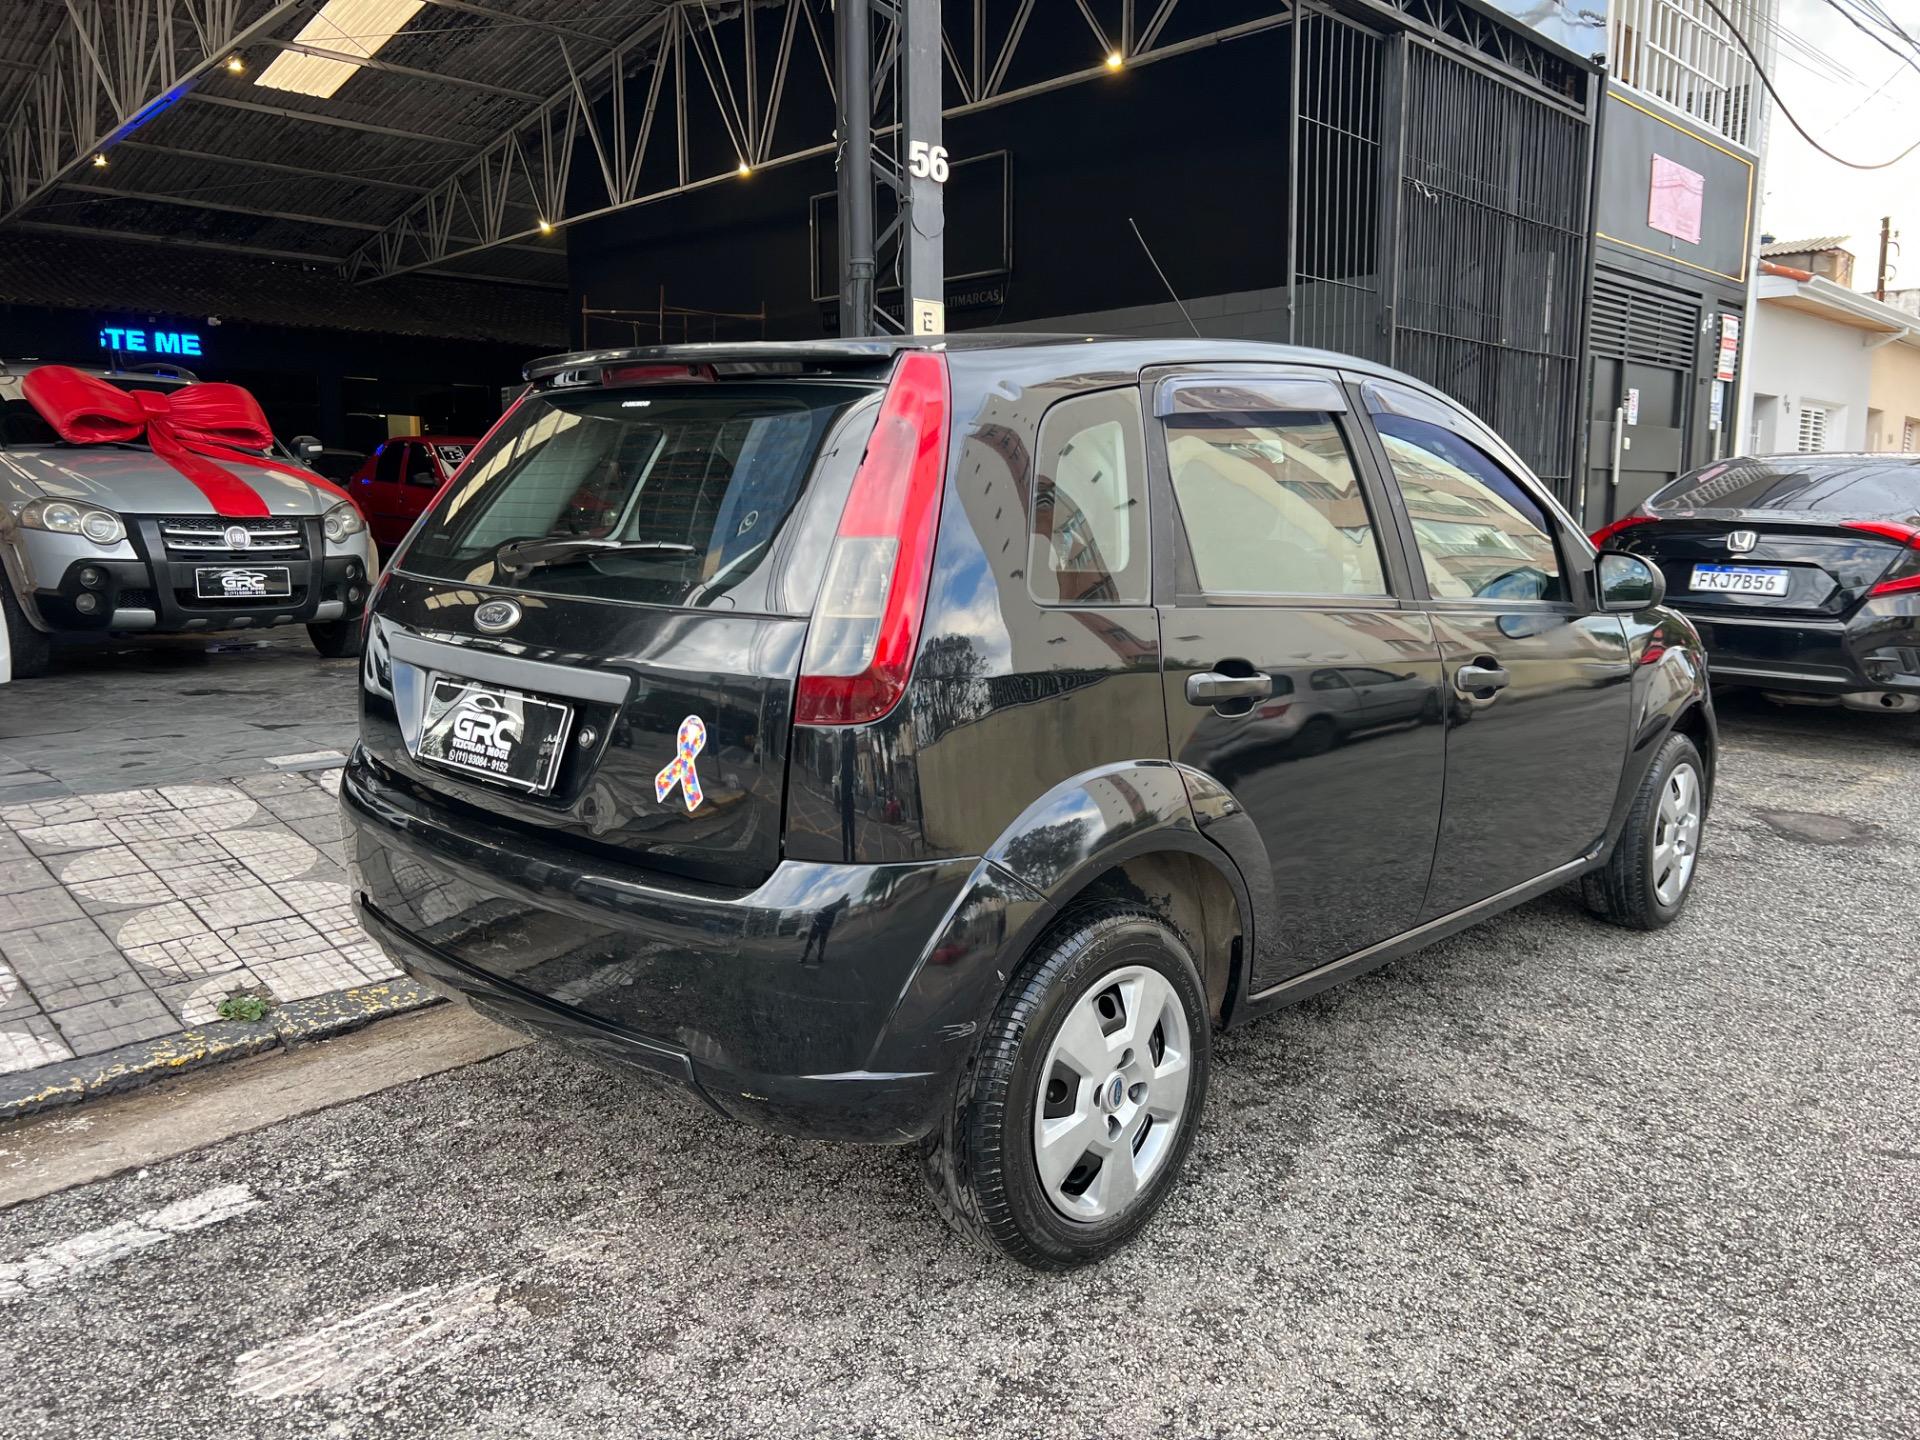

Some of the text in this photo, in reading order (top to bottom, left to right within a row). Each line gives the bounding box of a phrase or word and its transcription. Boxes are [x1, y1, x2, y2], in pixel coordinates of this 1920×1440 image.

[909, 140, 949, 183] 56
[154, 331, 202, 356] ME
[221, 576, 265, 589] GRC
[1698, 572, 1776, 592] FKJ7B56
[454, 710, 516, 751] GRC
[455, 750, 469, 765] (11)
[486, 746, 510, 761] MOGI
